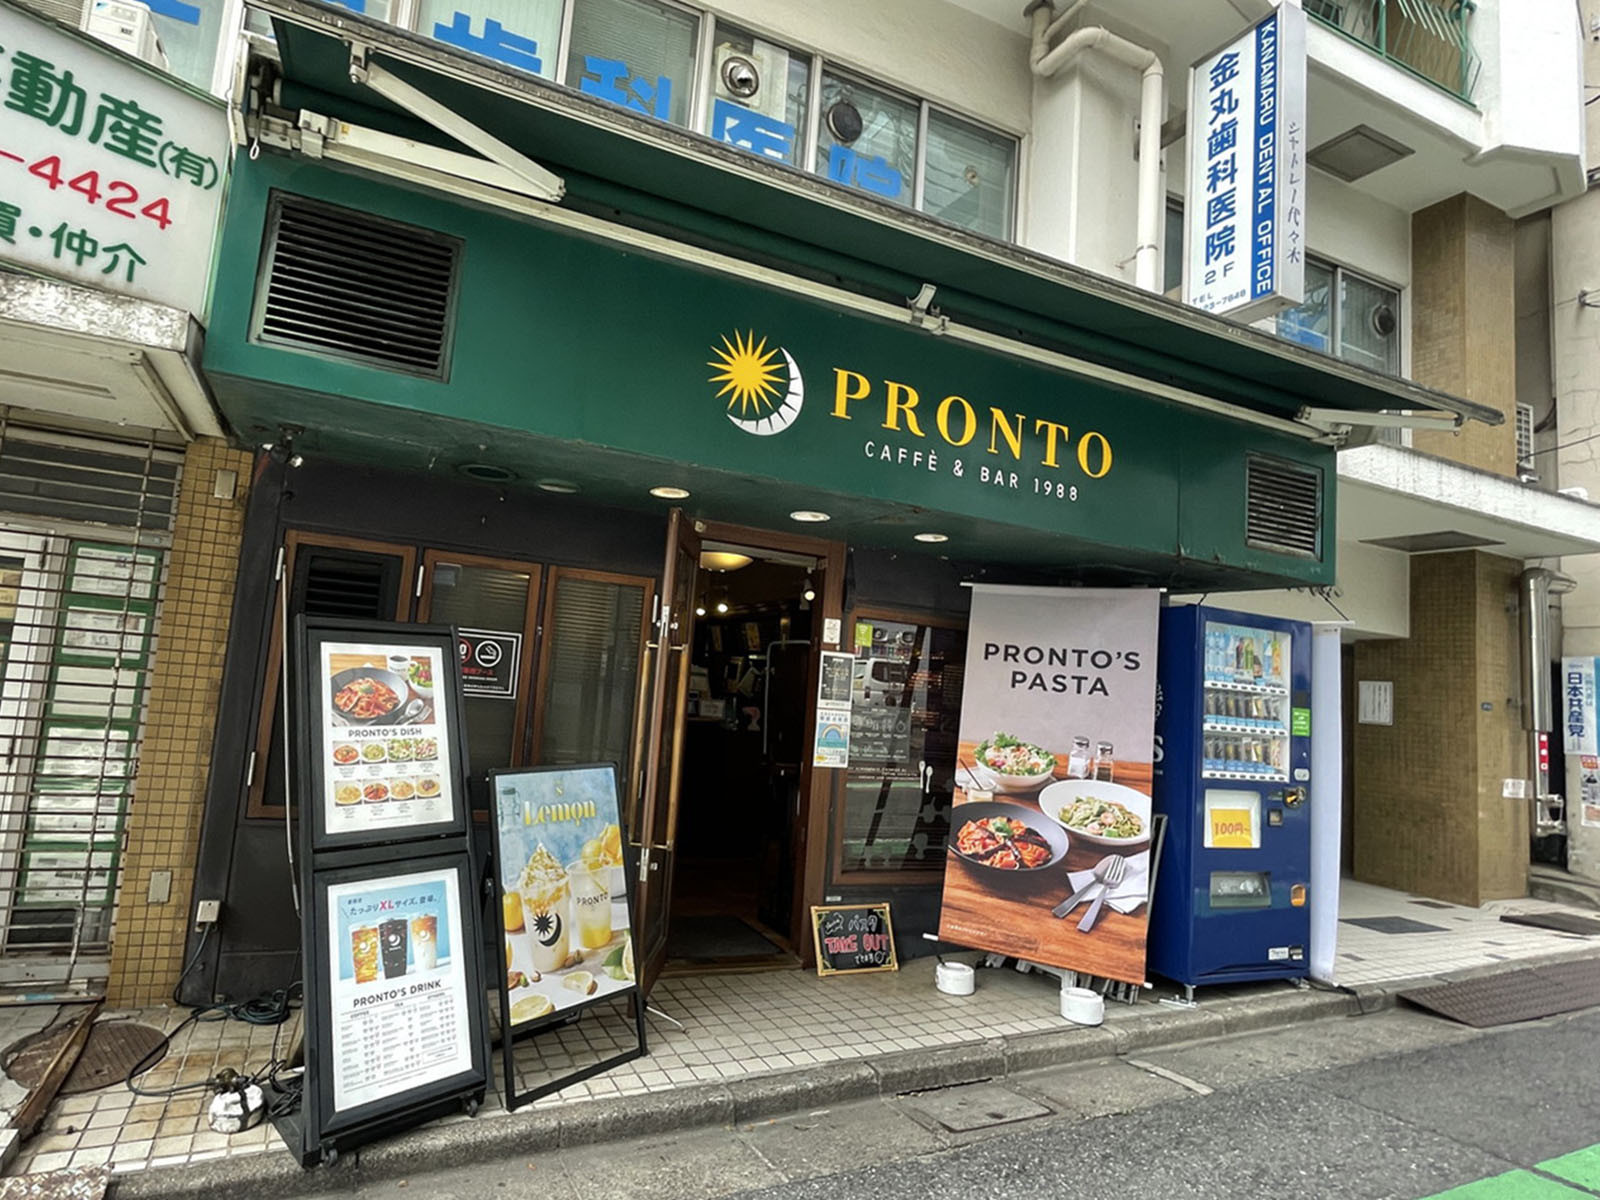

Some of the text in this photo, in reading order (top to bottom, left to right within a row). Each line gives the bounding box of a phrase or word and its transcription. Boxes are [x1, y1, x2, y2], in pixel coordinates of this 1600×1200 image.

[0, 46, 218, 190] 動産(有)
[1205, 52, 1241, 267] 金丸歯科医院
[1256, 21, 1276, 294] KANAMARU DENTAL OFFICE
[1192, 292, 1214, 305] TEL
[830, 367, 1113, 479] PRONTO
[865, 440, 1078, 502] CAFFÈ & BAR 1988
[983, 642, 1141, 671] PRONTO'S
[1010, 670, 1110, 697] PASTA
[1567, 671, 1584, 737] 日本共産党
[348, 727, 422, 738] PRONTO'S DISH
[524, 800, 597, 827] Lemon
[576, 891, 609, 905] PRONTO
[824, 932, 889, 954] TAKE OUT
[353, 979, 442, 1008] PRONTO'S DRINK
